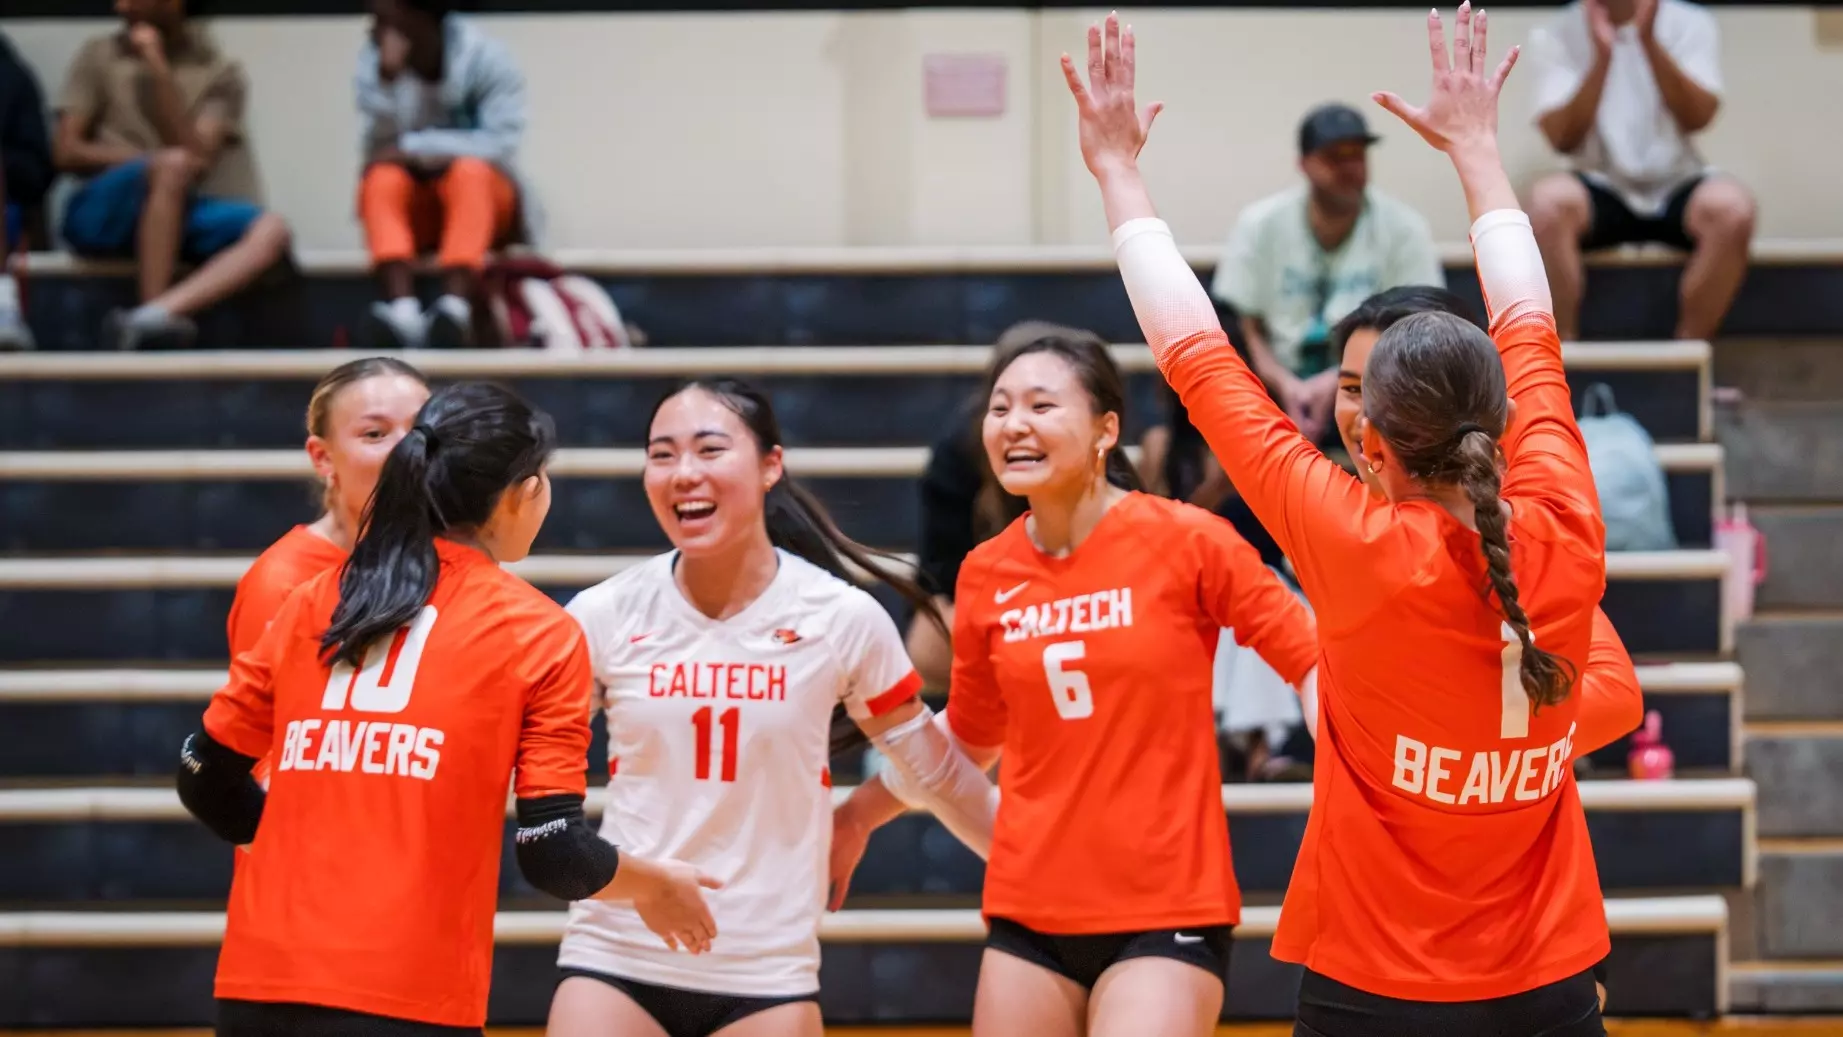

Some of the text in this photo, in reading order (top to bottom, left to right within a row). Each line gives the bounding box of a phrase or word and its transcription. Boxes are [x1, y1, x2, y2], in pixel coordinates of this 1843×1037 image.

[999, 586, 1134, 643] CALTECH
[649, 662, 787, 701] CALTECH
[1042, 640, 1094, 720] 6
[1500, 620, 1536, 739] 1
[278, 718, 445, 781] BEAVERS
[690, 705, 741, 783] 11
